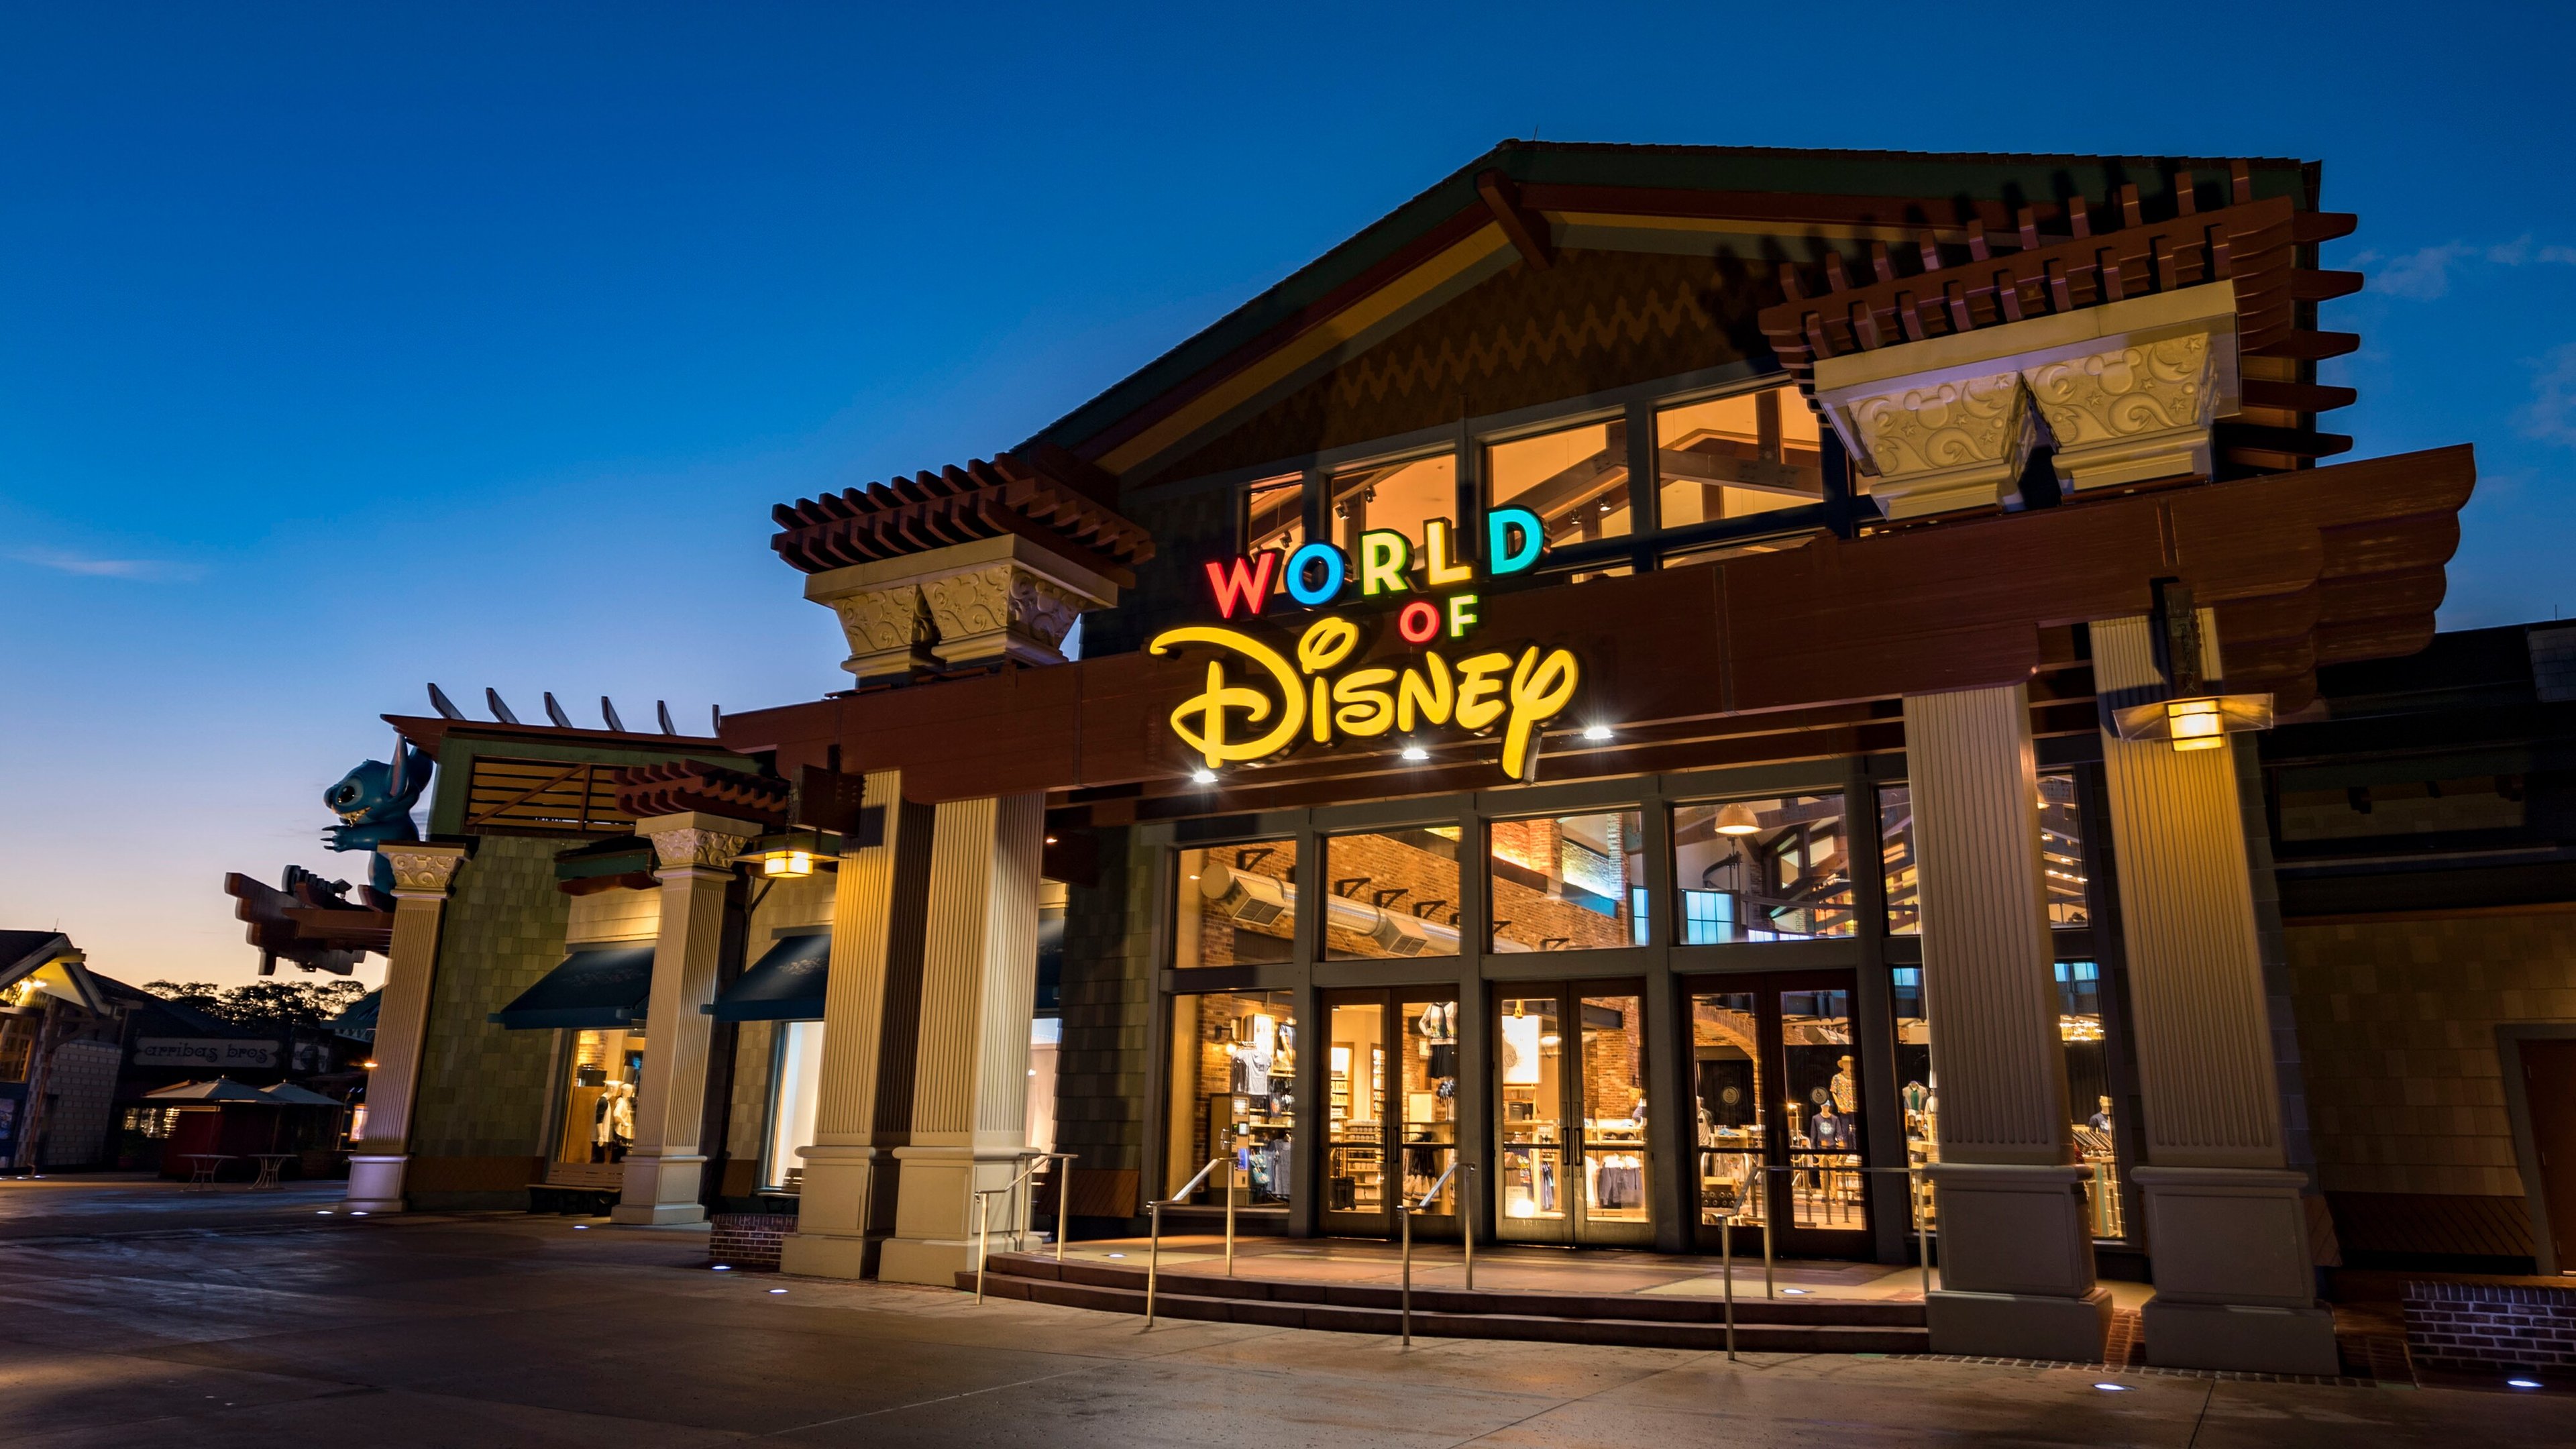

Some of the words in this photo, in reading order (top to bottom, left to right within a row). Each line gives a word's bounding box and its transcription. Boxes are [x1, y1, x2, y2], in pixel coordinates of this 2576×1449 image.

[1205, 508, 1545, 619] WORLD
[1399, 594, 1479, 643] OF
[144, 1042, 218, 1063] arribas
[225, 1044, 268, 1064] bros
